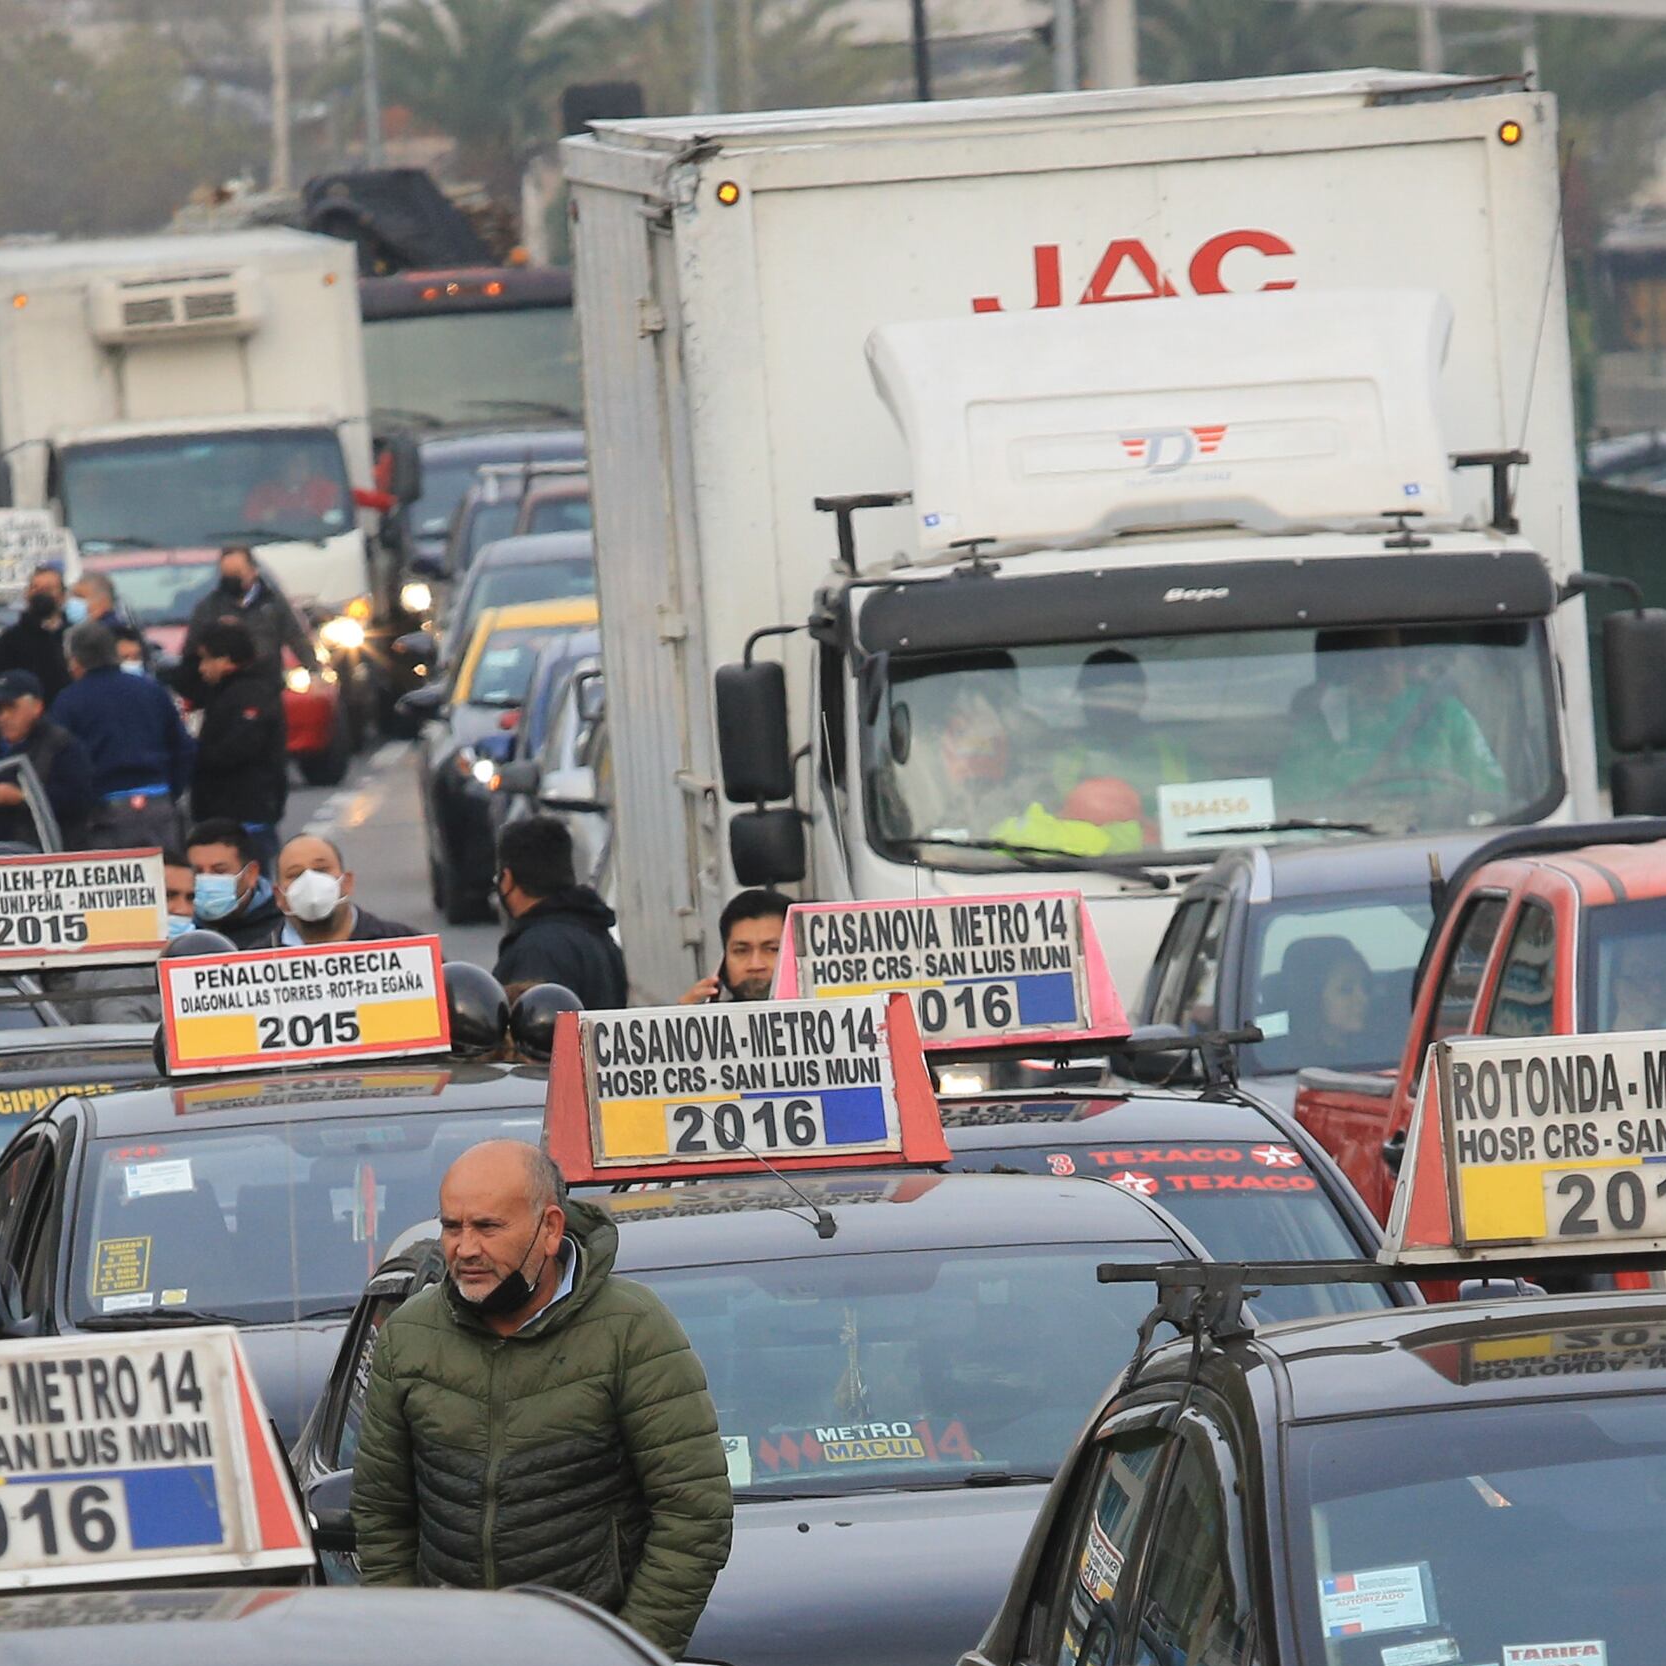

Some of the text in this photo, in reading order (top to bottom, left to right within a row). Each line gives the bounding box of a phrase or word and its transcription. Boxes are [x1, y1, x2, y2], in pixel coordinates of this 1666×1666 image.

[79, 887, 156, 909] ANTUPIREN
[809, 899, 1067, 957] CASANOVA METRO 14
[813, 946, 1072, 985] HOSP. CRS SAN LUIS MUNI
[181, 992, 243, 1014] DIAGONAL
[247, 989, 271, 1007] LAS
[273, 984, 323, 1005] TORRES
[382, 970, 423, 994] EGAÑA
[919, 984, 1012, 1032] 016
[259, 1010, 360, 1049] 2015
[840, 1007, 877, 1054] 14
[597, 1055, 881, 1098] HOSP. CRS SAN LUIS MUNI
[673, 1099, 817, 1153] 2016
[1458, 1125, 1535, 1164] HOSP.
[1046, 1148, 1243, 1176] 3 TEXACO
[1164, 1174, 1316, 1192] TEXACO
[150, 1350, 203, 1415] 14
[49, 1427, 119, 1468] LUIS
[132, 1421, 212, 1461] MUNI
[815, 1421, 912, 1443] METRO
[826, 1420, 974, 1463] MACUL 14
[1507, 1645, 1600, 1660] TARIFA
